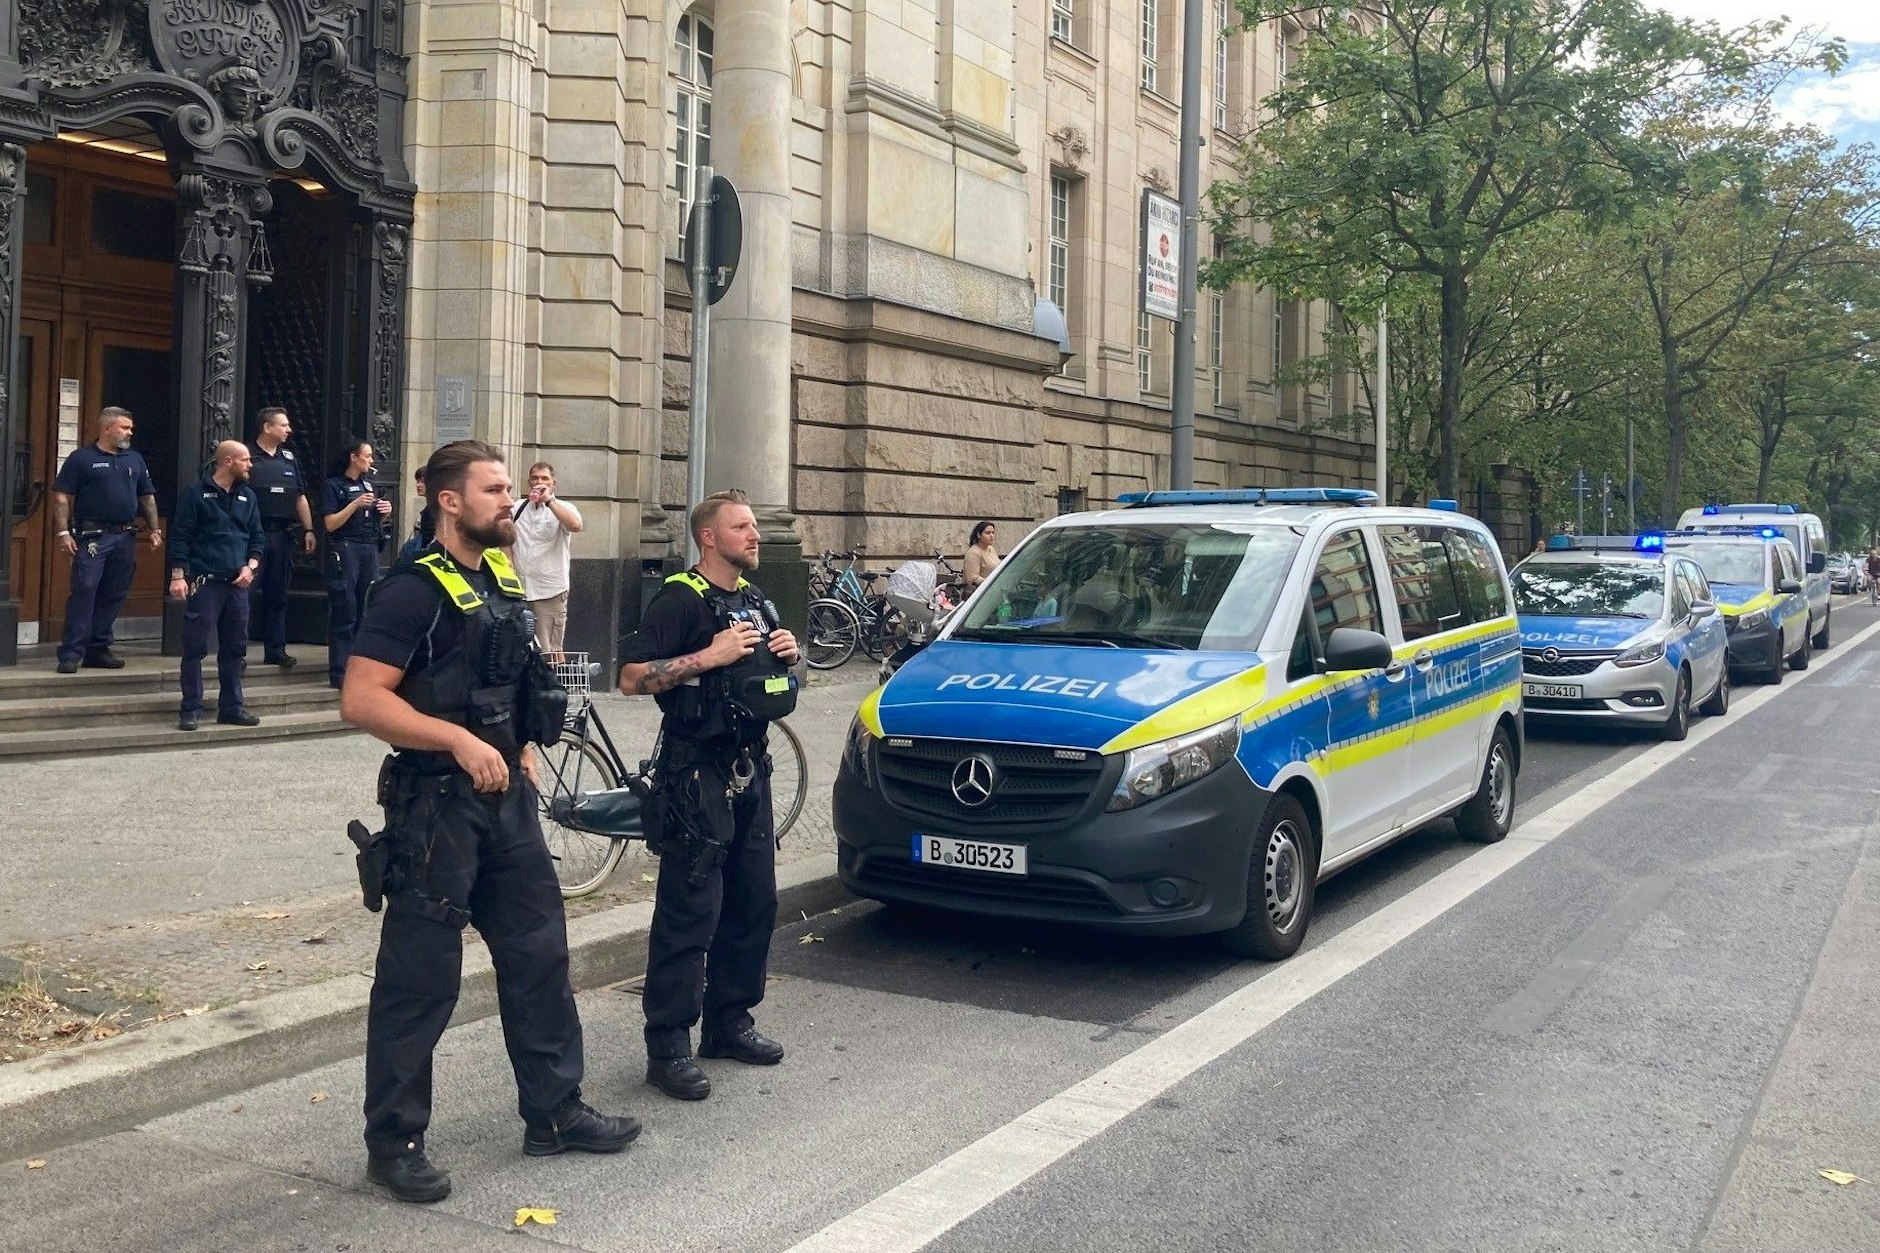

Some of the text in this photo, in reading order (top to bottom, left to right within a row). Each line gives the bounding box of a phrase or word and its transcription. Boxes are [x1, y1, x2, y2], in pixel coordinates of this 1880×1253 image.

[936, 673, 1109, 699] POLIZEI
[1426, 658, 1472, 700] POLIZEI
[1528, 685, 1576, 697] B 30410
[931, 840, 1014, 870] B 30523
